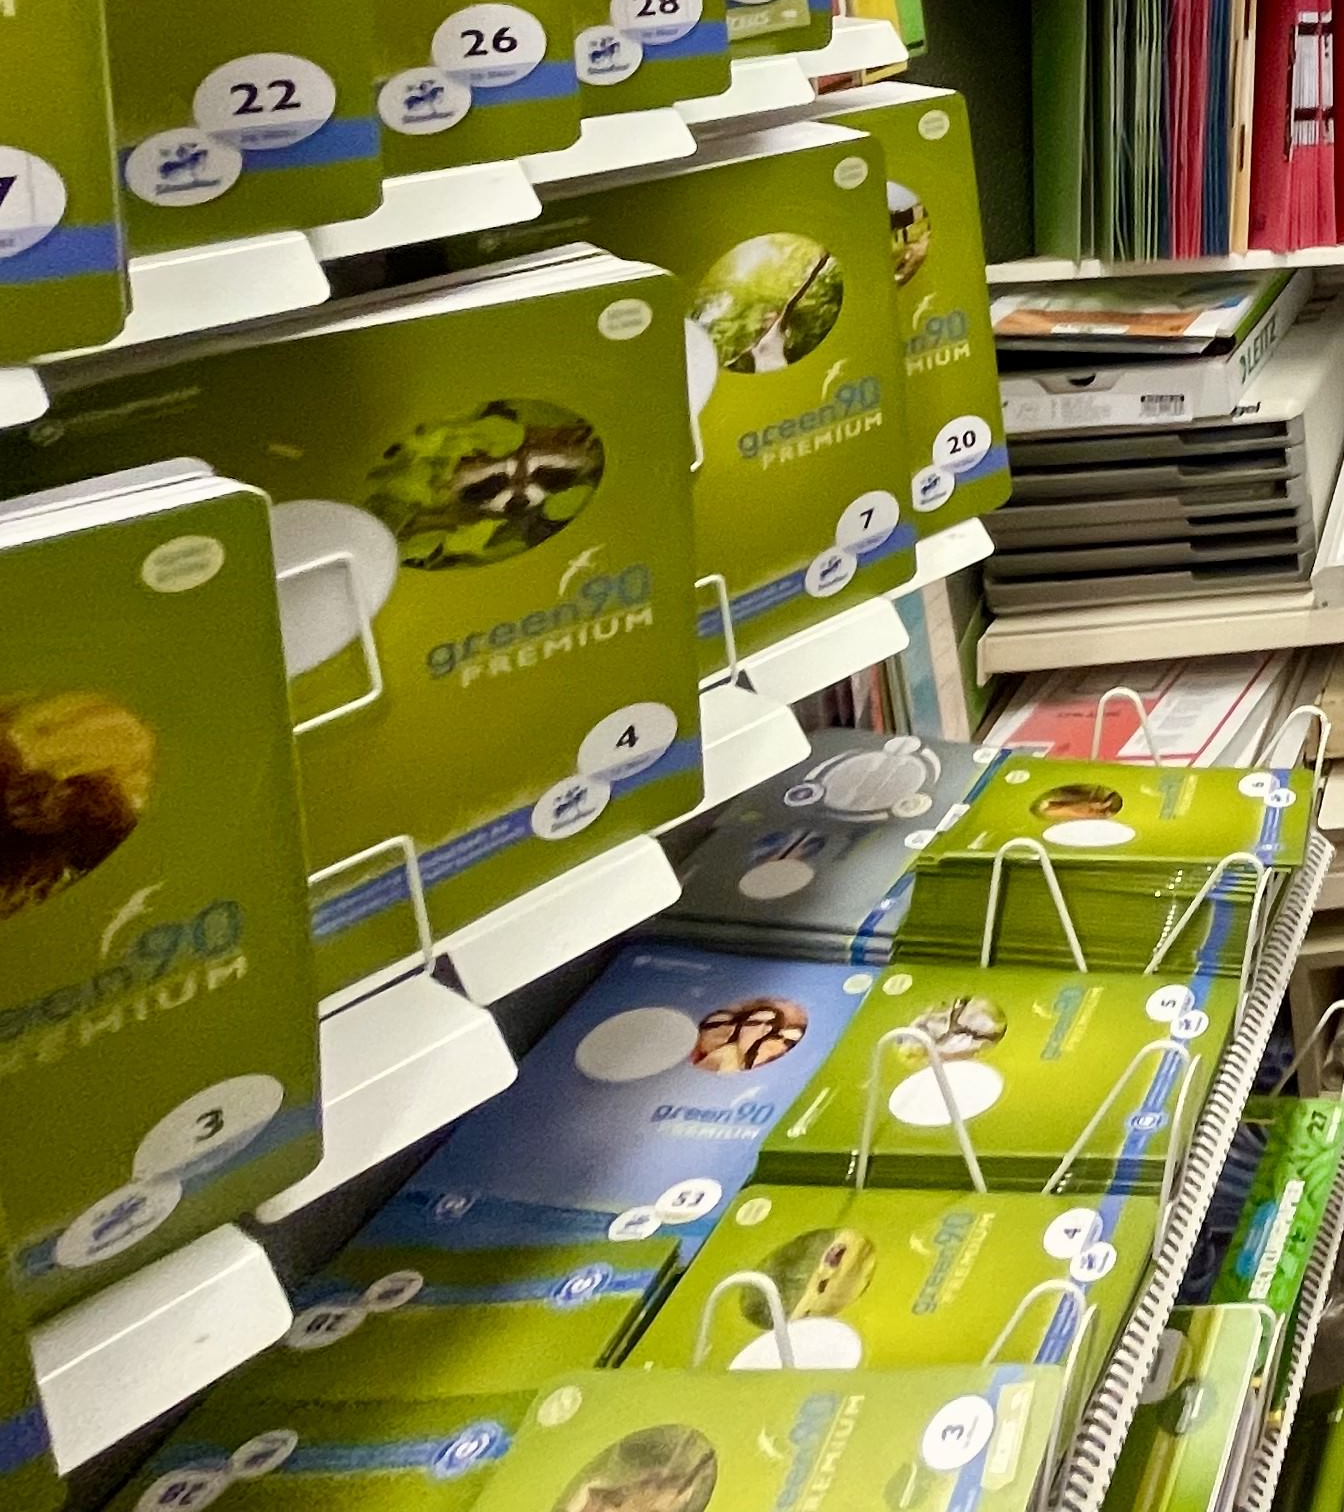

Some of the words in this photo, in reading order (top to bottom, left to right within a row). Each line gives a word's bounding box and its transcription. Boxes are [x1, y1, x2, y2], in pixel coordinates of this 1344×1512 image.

[460, 26, 519, 59] 26
[230, 78, 303, 117] 22
[760, 411, 884, 471] PREMIUM
[947, 430, 976, 455] 20
[860, 508, 875, 531] 7
[459, 607, 655, 689] PREMIUM
[615, 724, 639, 752] 4
[195, 1108, 225, 1142] 3
[941, 1423, 965, 1442] 3
